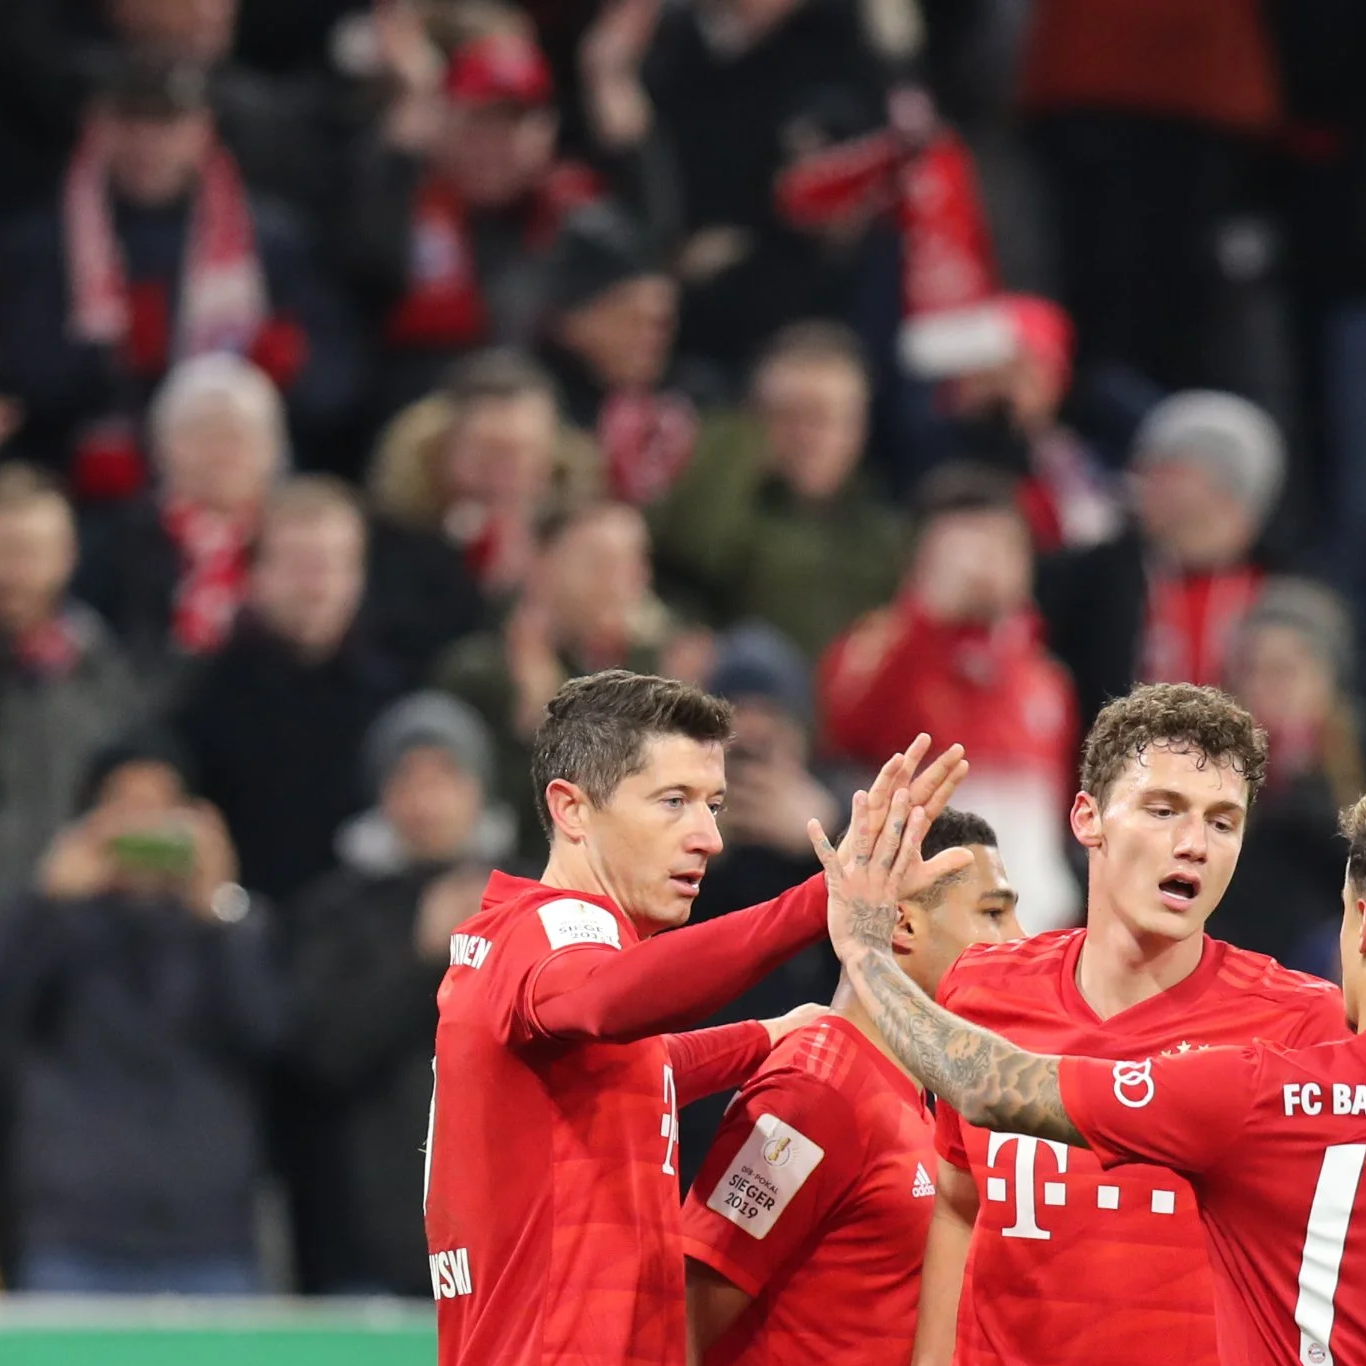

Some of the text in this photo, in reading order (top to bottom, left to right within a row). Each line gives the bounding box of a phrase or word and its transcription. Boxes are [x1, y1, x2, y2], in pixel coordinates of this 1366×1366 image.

[1283, 1082, 1322, 1116] FC
[724, 1191, 758, 1219] 2019
[729, 1174, 775, 1211] SIEGER
